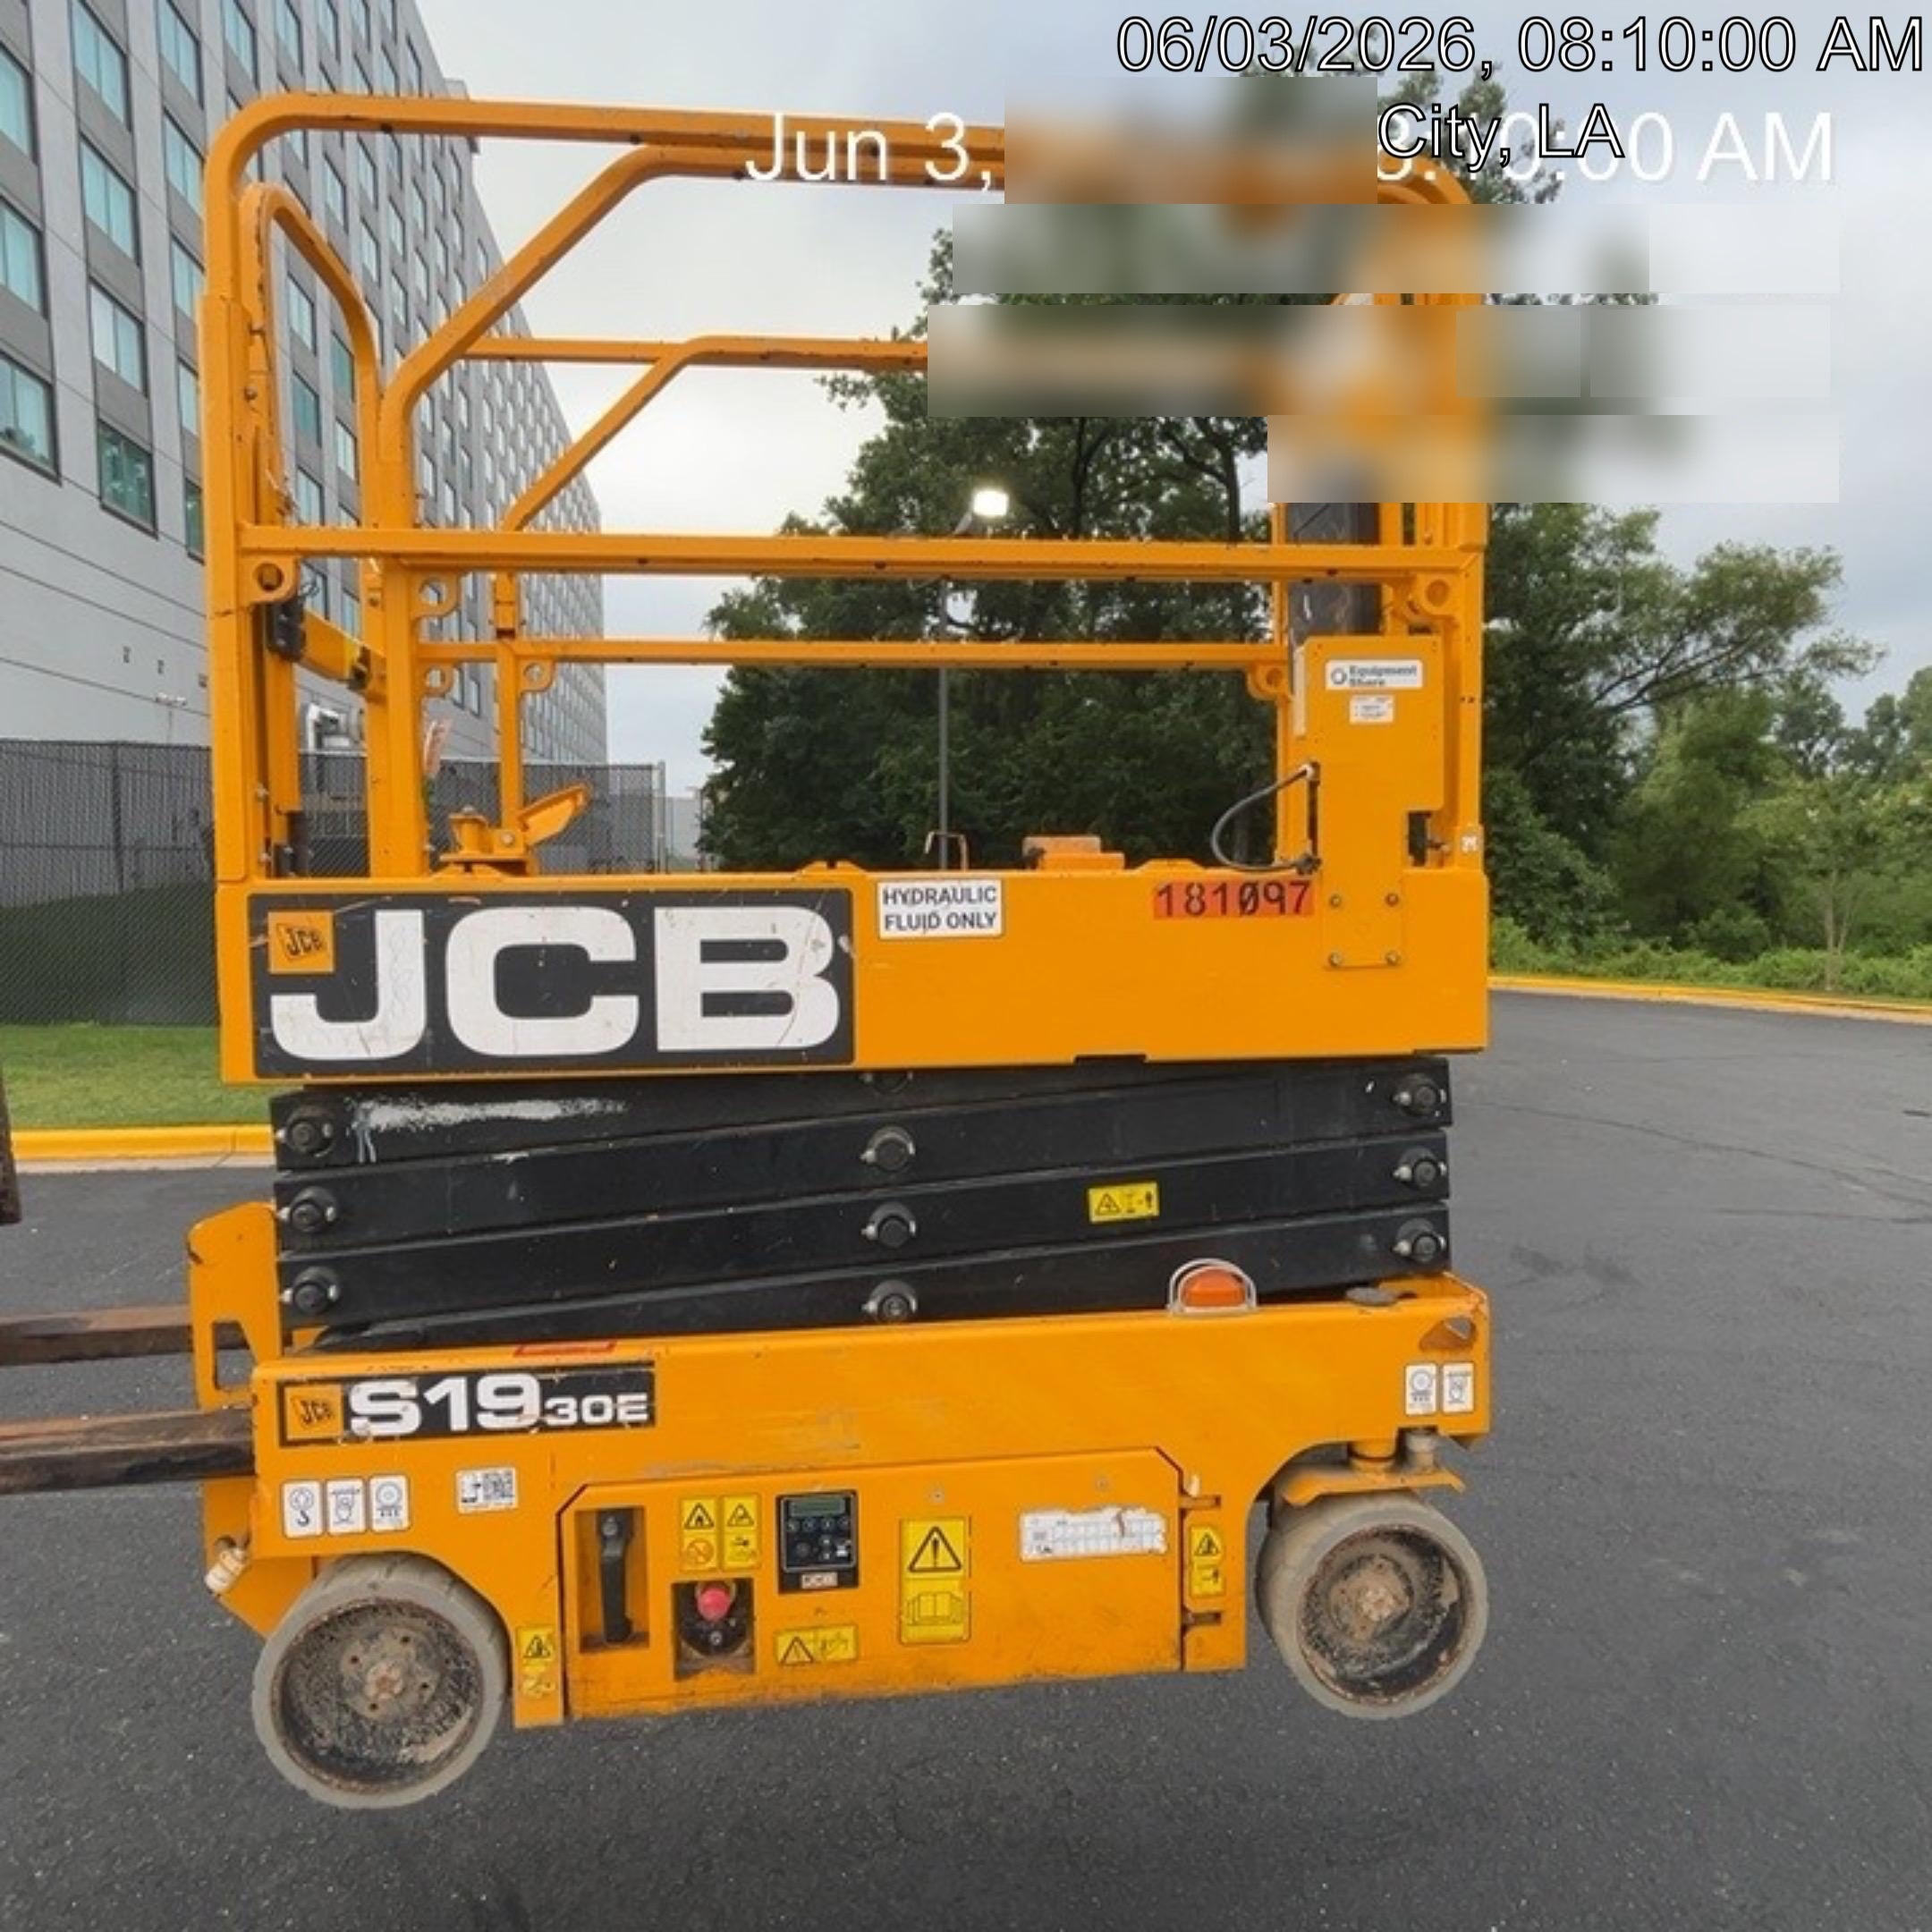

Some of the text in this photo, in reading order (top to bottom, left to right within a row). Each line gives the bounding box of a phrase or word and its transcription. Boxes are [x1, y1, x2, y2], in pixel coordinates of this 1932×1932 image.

[883, 886, 997, 906] HYDRAULIC
[1157, 880, 1311, 917] 181097
[885, 911, 996, 932] FLUID ONLY
[269, 906, 841, 1062] JCB
